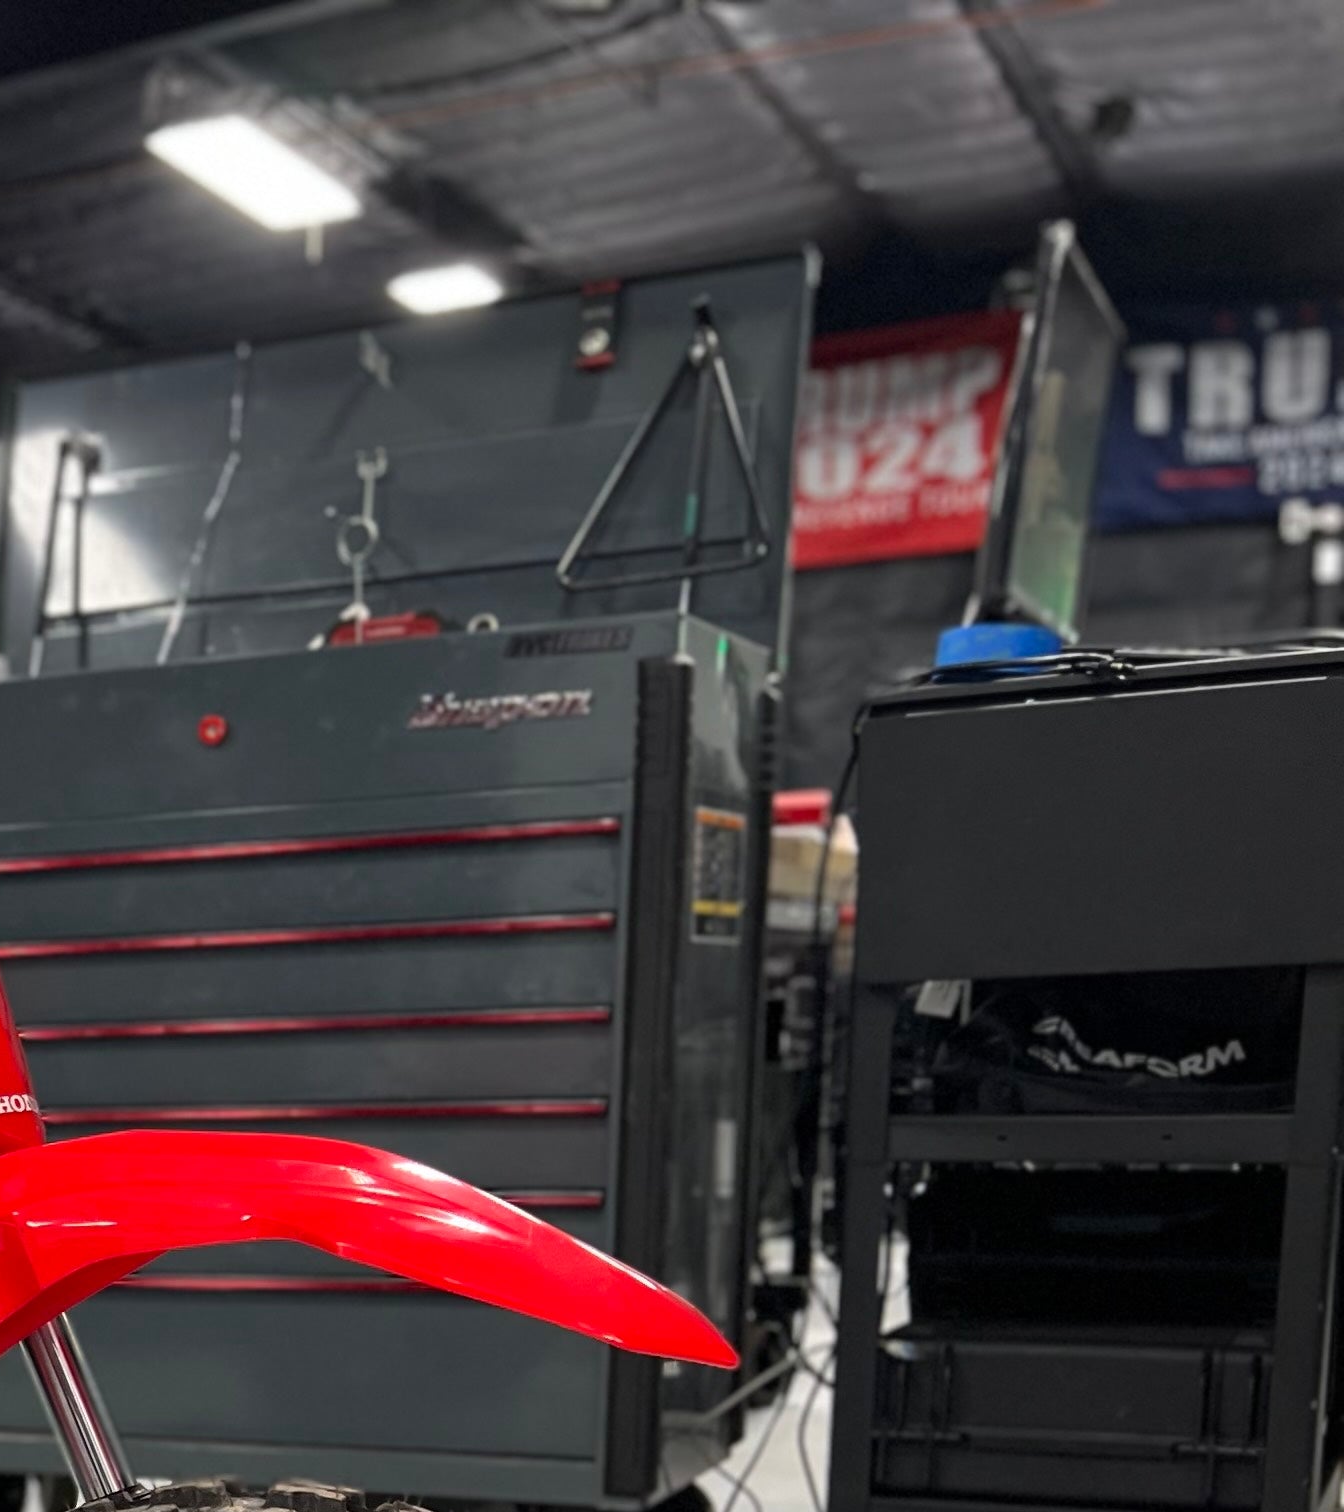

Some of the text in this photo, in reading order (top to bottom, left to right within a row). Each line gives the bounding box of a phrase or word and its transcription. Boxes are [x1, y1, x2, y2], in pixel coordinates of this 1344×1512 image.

[798, 348, 1002, 434] RUMP
[1126, 326, 1344, 437] TRU
[798, 410, 986, 500] 024
